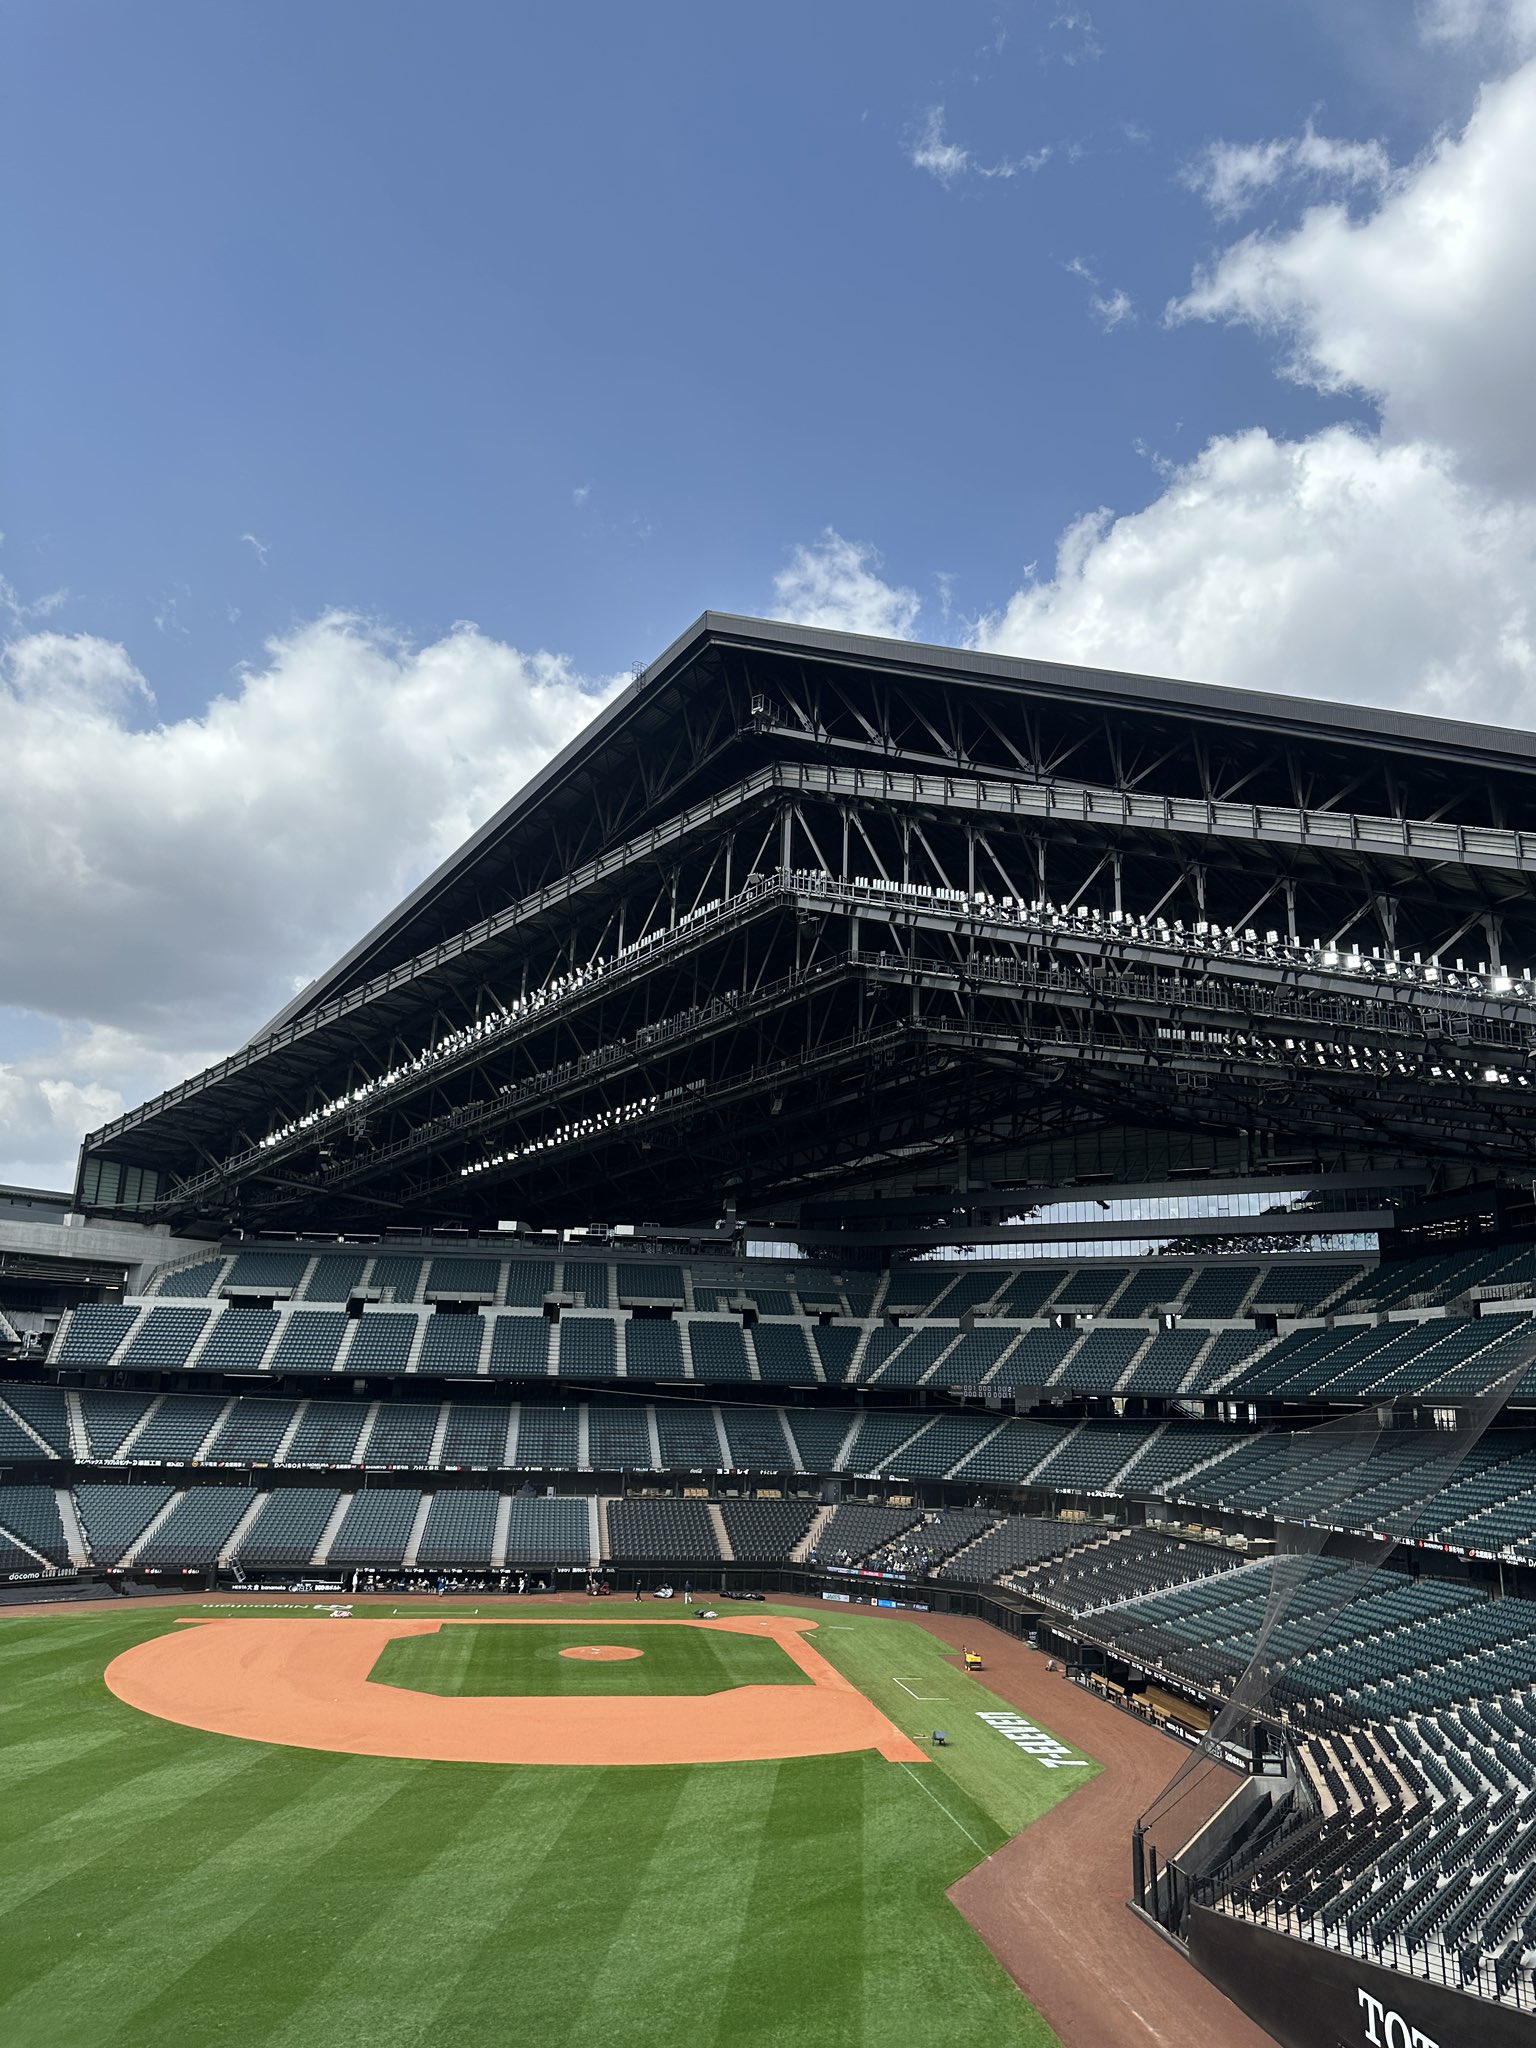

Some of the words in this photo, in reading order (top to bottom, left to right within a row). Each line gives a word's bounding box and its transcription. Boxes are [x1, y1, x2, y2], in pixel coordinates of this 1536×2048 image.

[8, 1572, 40, 1581] docomo
[41, 1569, 57, 1578] CLUB
[57, 1567, 79, 1577] LOUNGE
